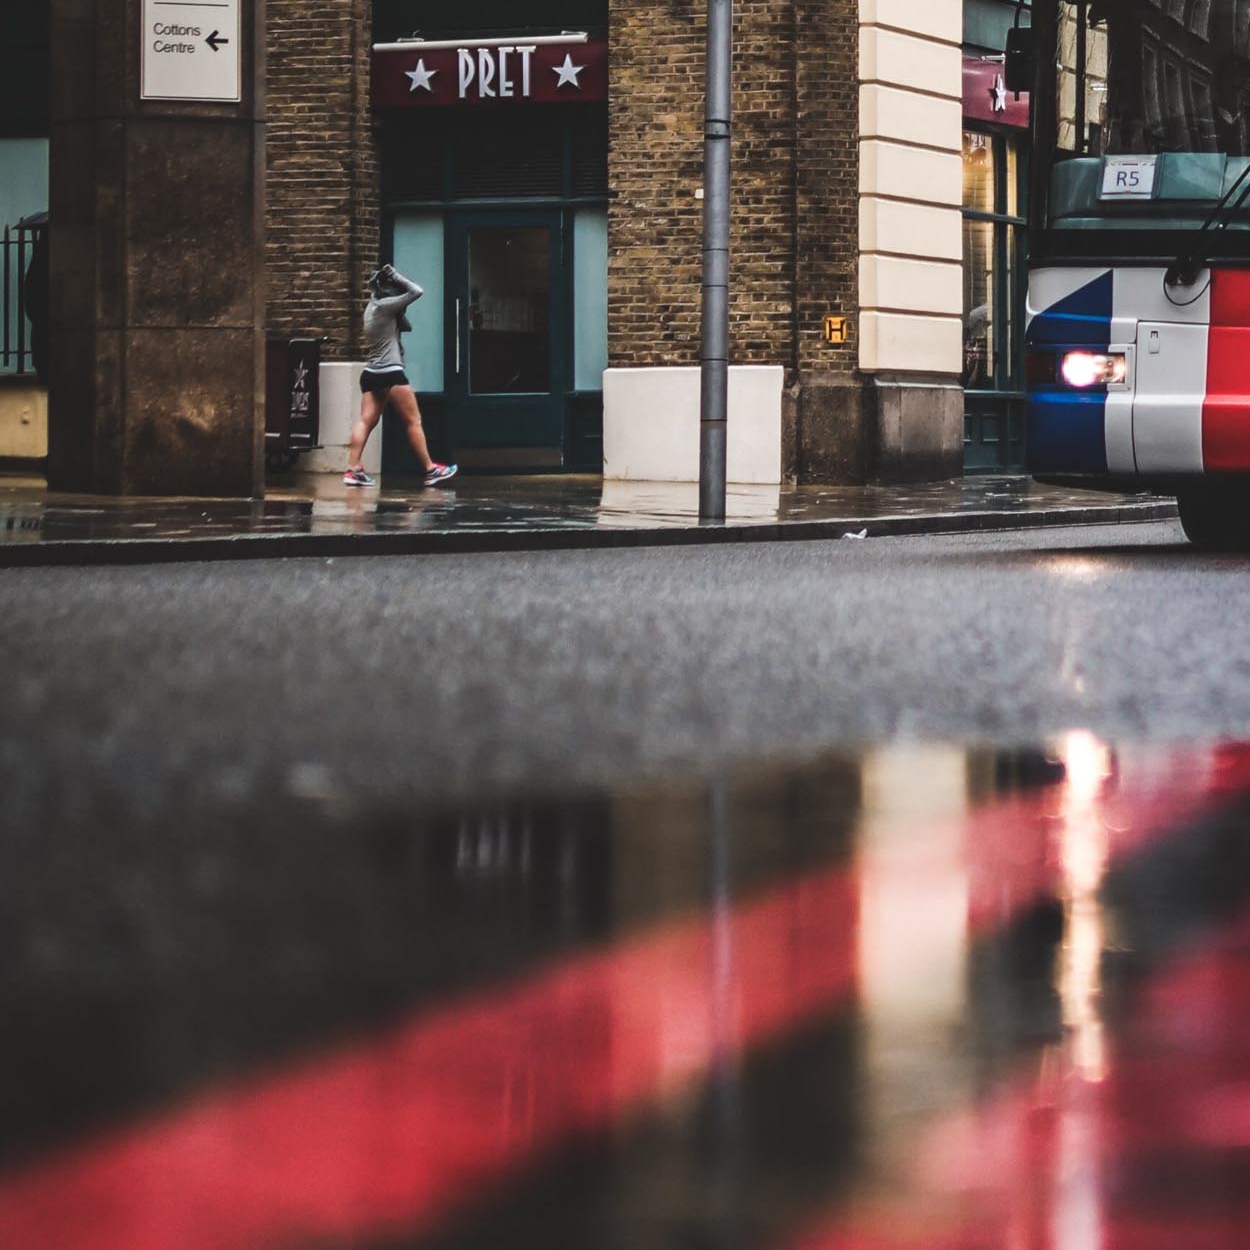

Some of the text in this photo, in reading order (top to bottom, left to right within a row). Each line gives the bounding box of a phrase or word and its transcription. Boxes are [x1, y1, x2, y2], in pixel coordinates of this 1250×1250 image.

[153, 22, 201, 37] Cottons
[153, 40, 195, 54] Centre
[457, 45, 537, 98] PRET
[1116, 170, 1140, 187] R5
